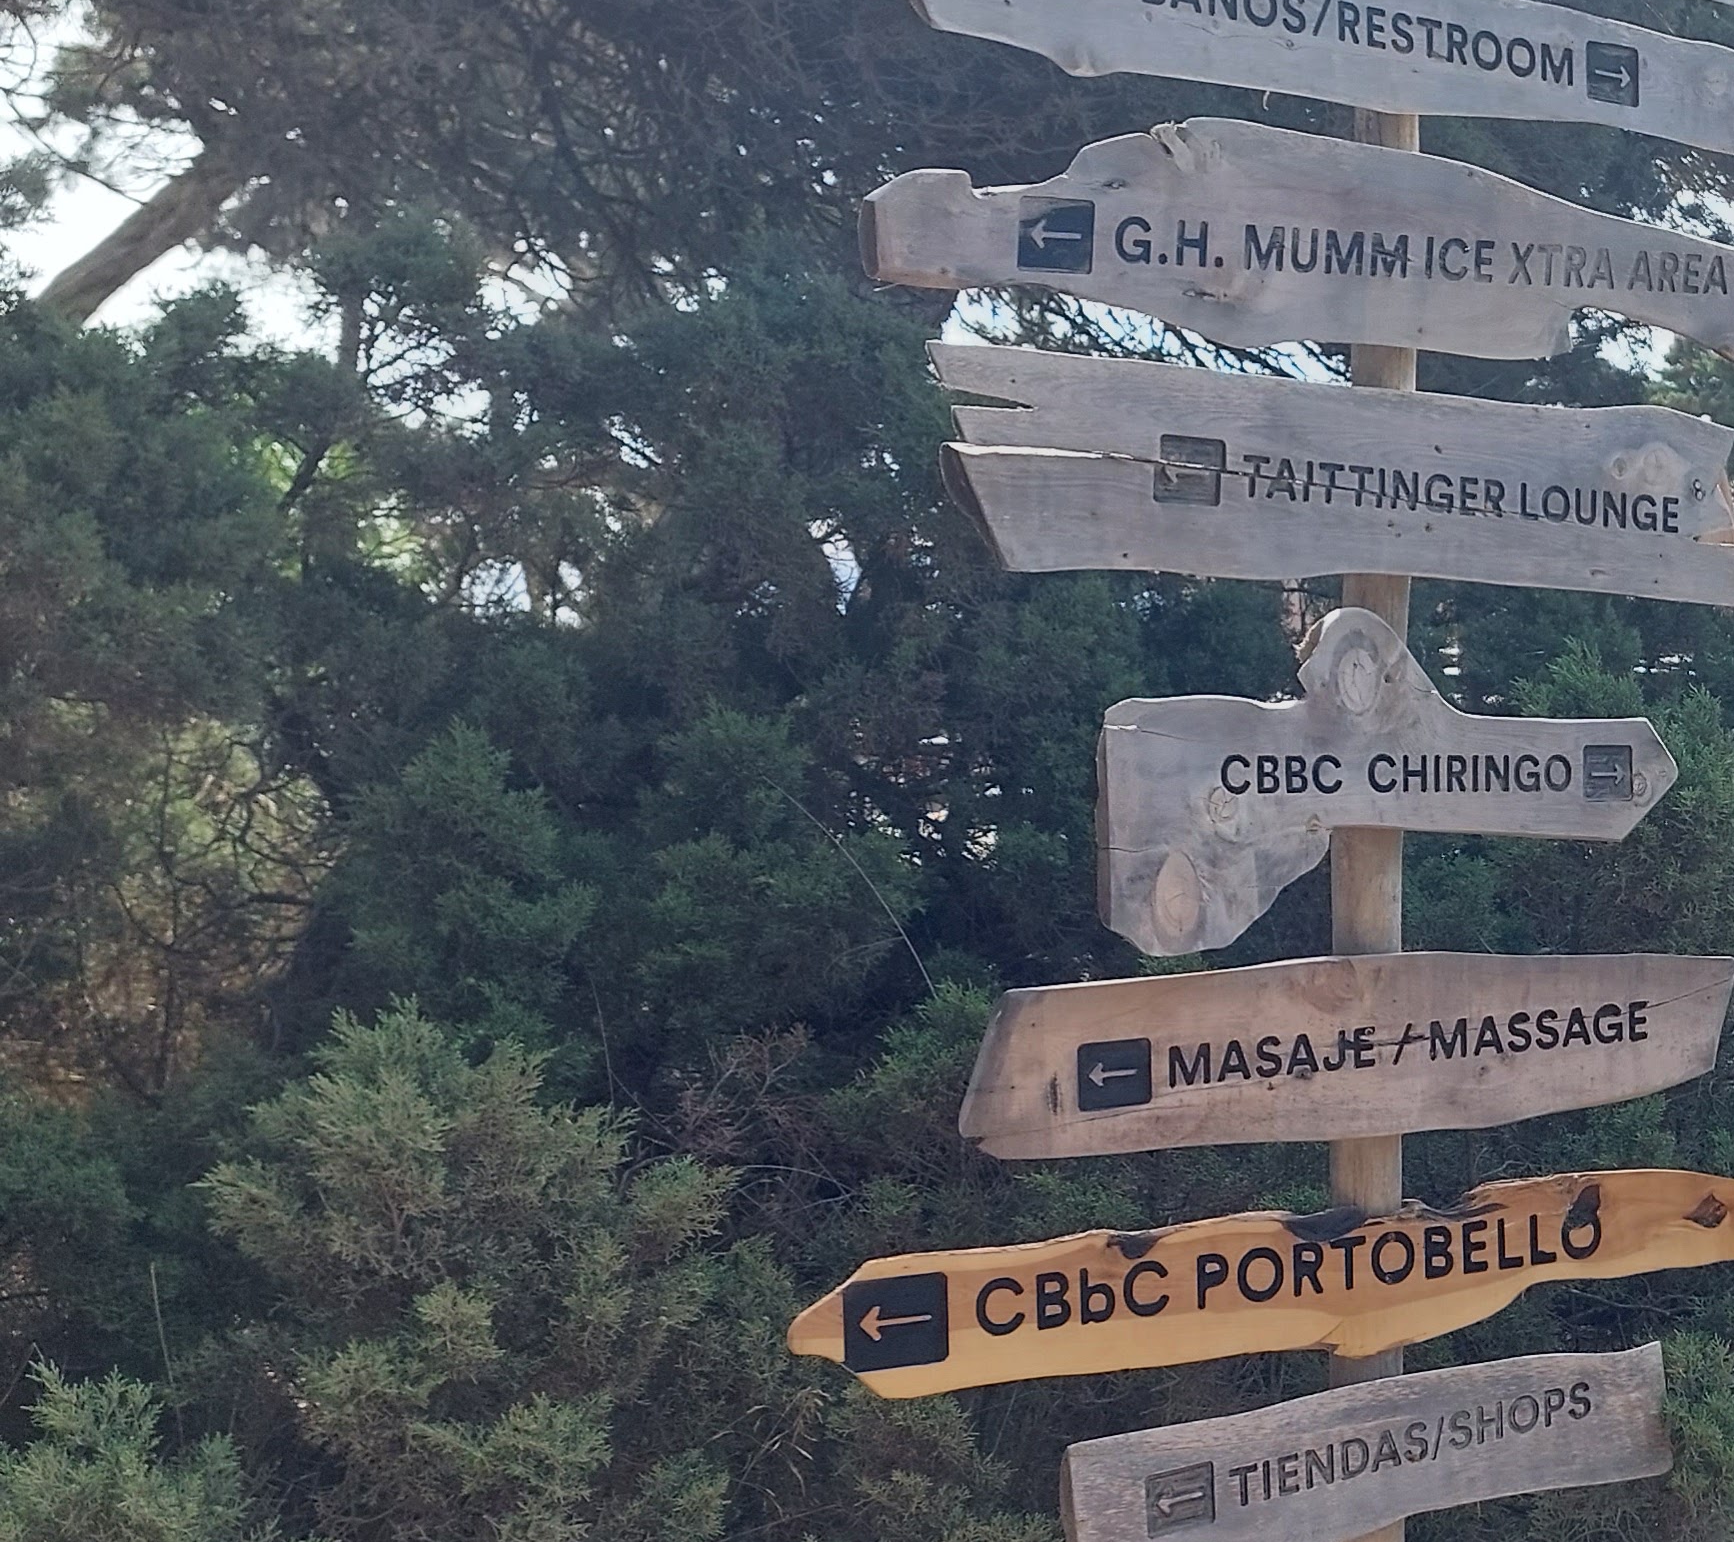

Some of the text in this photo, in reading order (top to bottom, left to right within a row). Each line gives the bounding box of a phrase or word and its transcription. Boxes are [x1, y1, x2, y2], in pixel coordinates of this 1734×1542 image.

[1115, 217, 1728, 295] G.H. MUMM ICE XTRA AREA
[1243, 454, 1679, 534] TAITTINGER LOUNGE
[1220, 752, 1572, 794] CBBC CHIRINGO
[1167, 1025, 1375, 1087] MASAJE
[1430, 1000, 1649, 1061] MASSAGE
[975, 1209, 1601, 1338] CBbC PORTOBELLO
[1227, 1382, 1592, 1507] TIENDAS/SHOPS
